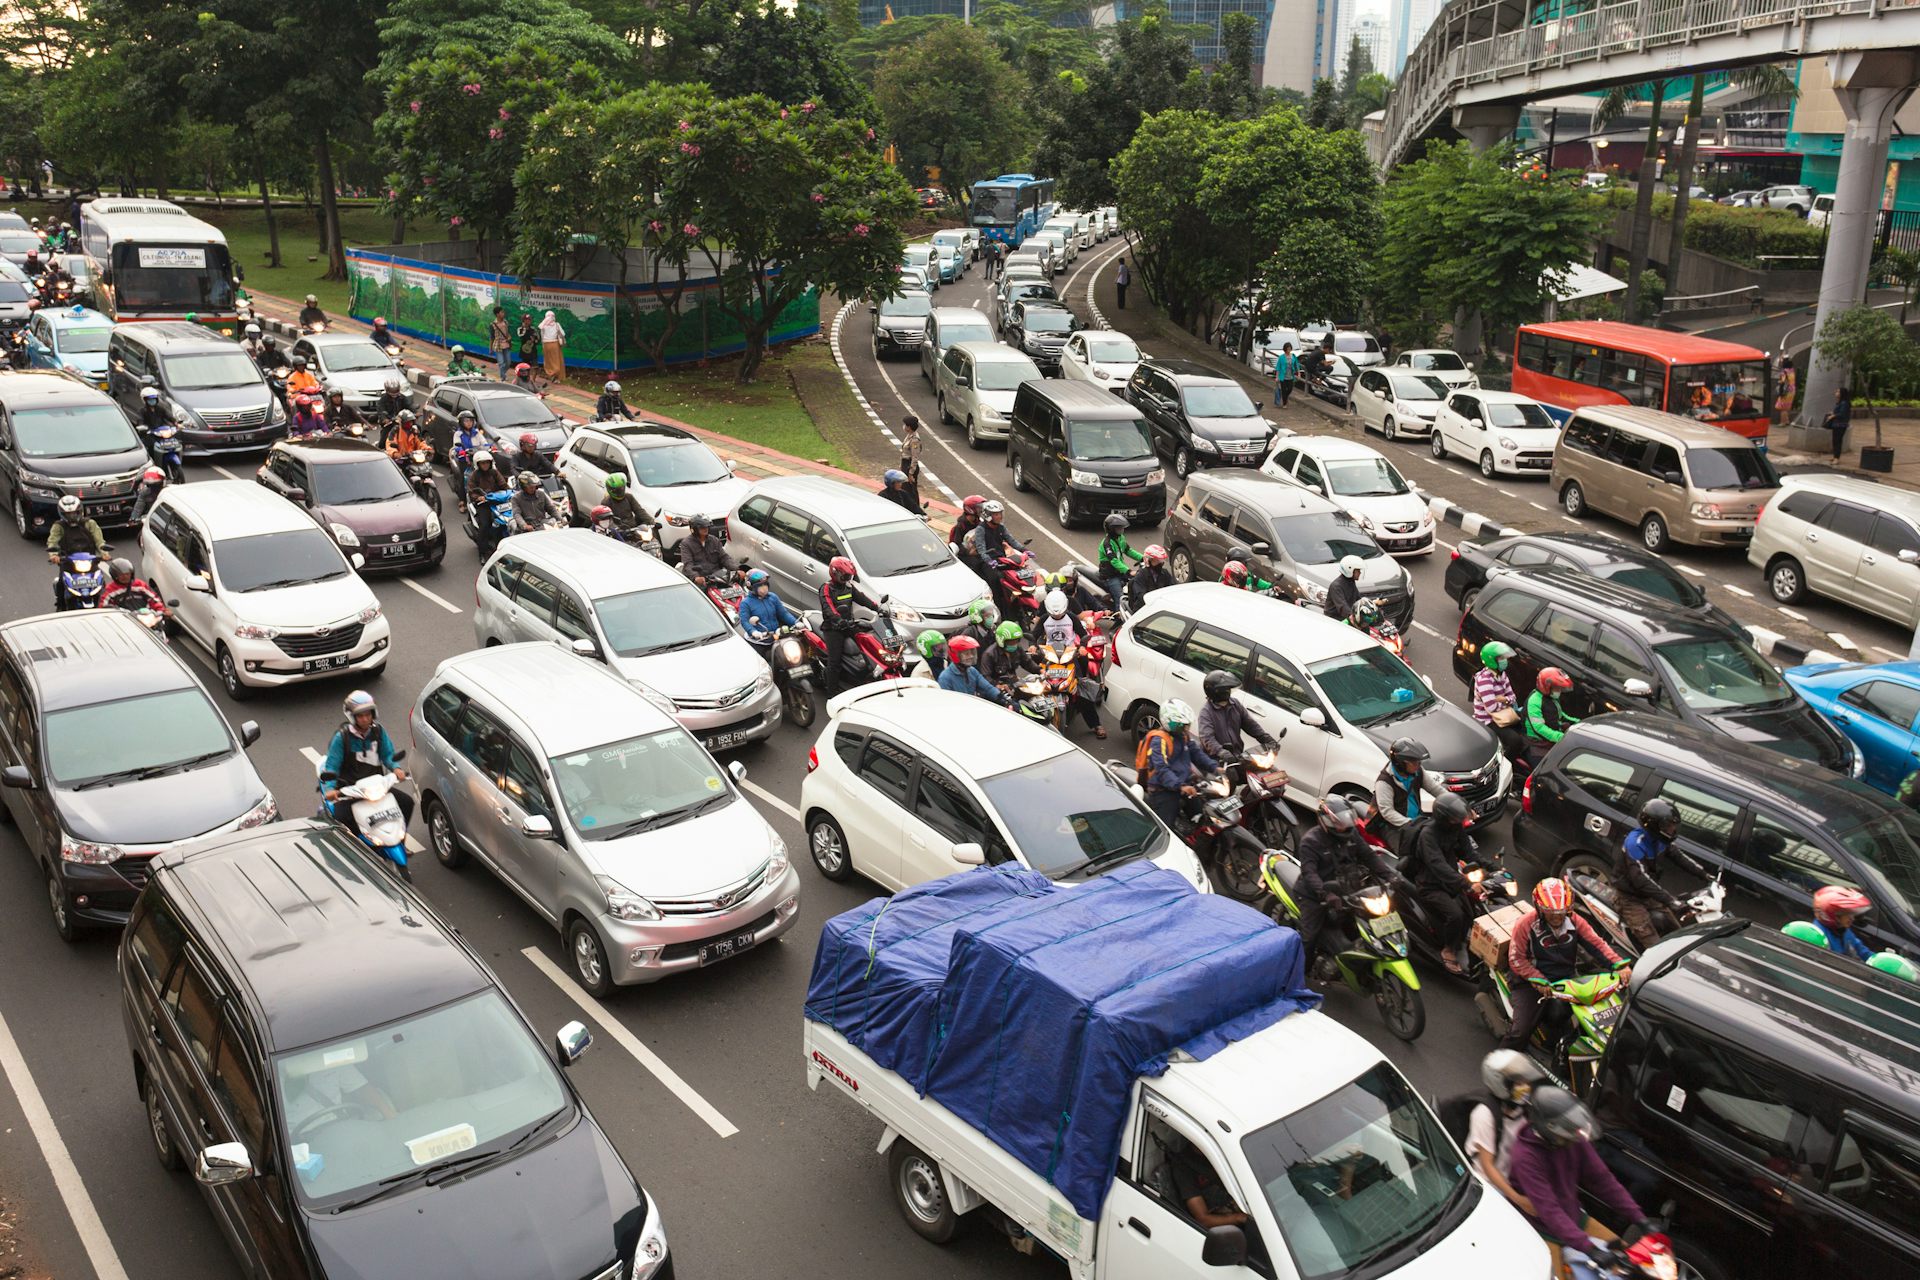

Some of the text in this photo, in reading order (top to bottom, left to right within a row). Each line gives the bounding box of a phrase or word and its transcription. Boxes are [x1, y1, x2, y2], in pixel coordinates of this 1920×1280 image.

[553, 294, 586, 302] REVITALISASI
[306, 661, 310, 670] B
[315, 658, 330, 668] 1302
[336, 655, 347, 664] KIF
[708, 738, 714, 747] B
[718, 734, 732, 745] 1952
[733, 730, 746, 742] FKM
[702, 949, 707, 960] B
[716, 940, 732, 954] 1756
[738, 932, 752, 946] CKM
[1594, 1014, 1600, 1022] B
[816, 1053, 853, 1088] XTRA
[1148, 1103, 1168, 1118] APV
